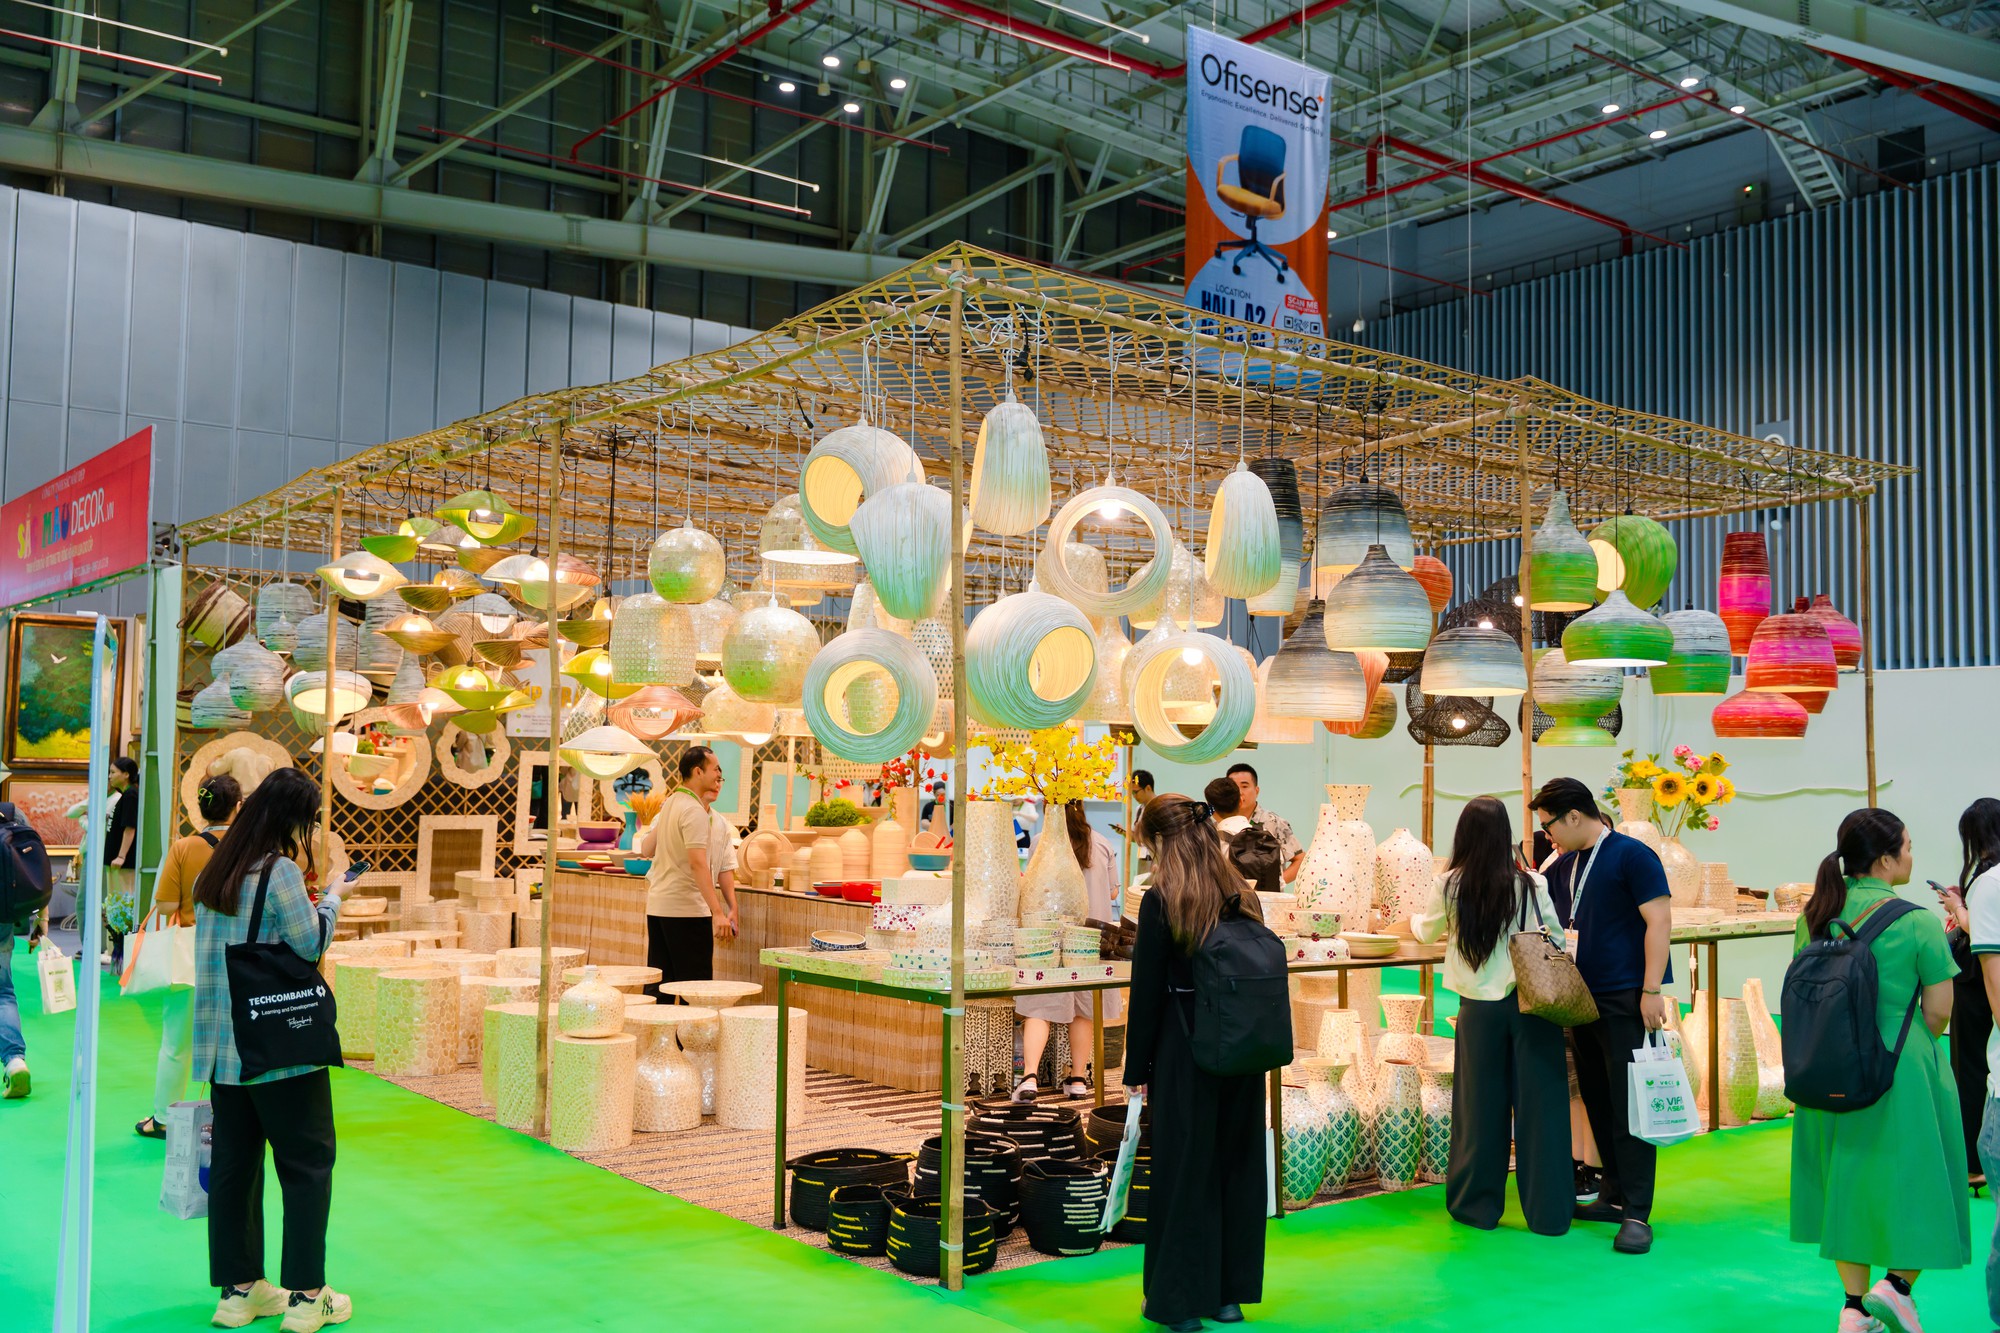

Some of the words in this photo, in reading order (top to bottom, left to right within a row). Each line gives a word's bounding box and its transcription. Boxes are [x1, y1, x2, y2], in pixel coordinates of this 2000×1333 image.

[1201, 54, 1319, 120] Ofisense
[1201, 90, 1233, 106] Ergonomic
[1215, 284, 1251, 299] LOCATION
[1287, 296, 1305, 307] SCAN
[1306, 301, 1318, 309] ME
[1245, 303, 1266, 325] A2
[249, 989, 313, 1005] TECHCOMBANK
[290, 1002, 318, 1011] Development
